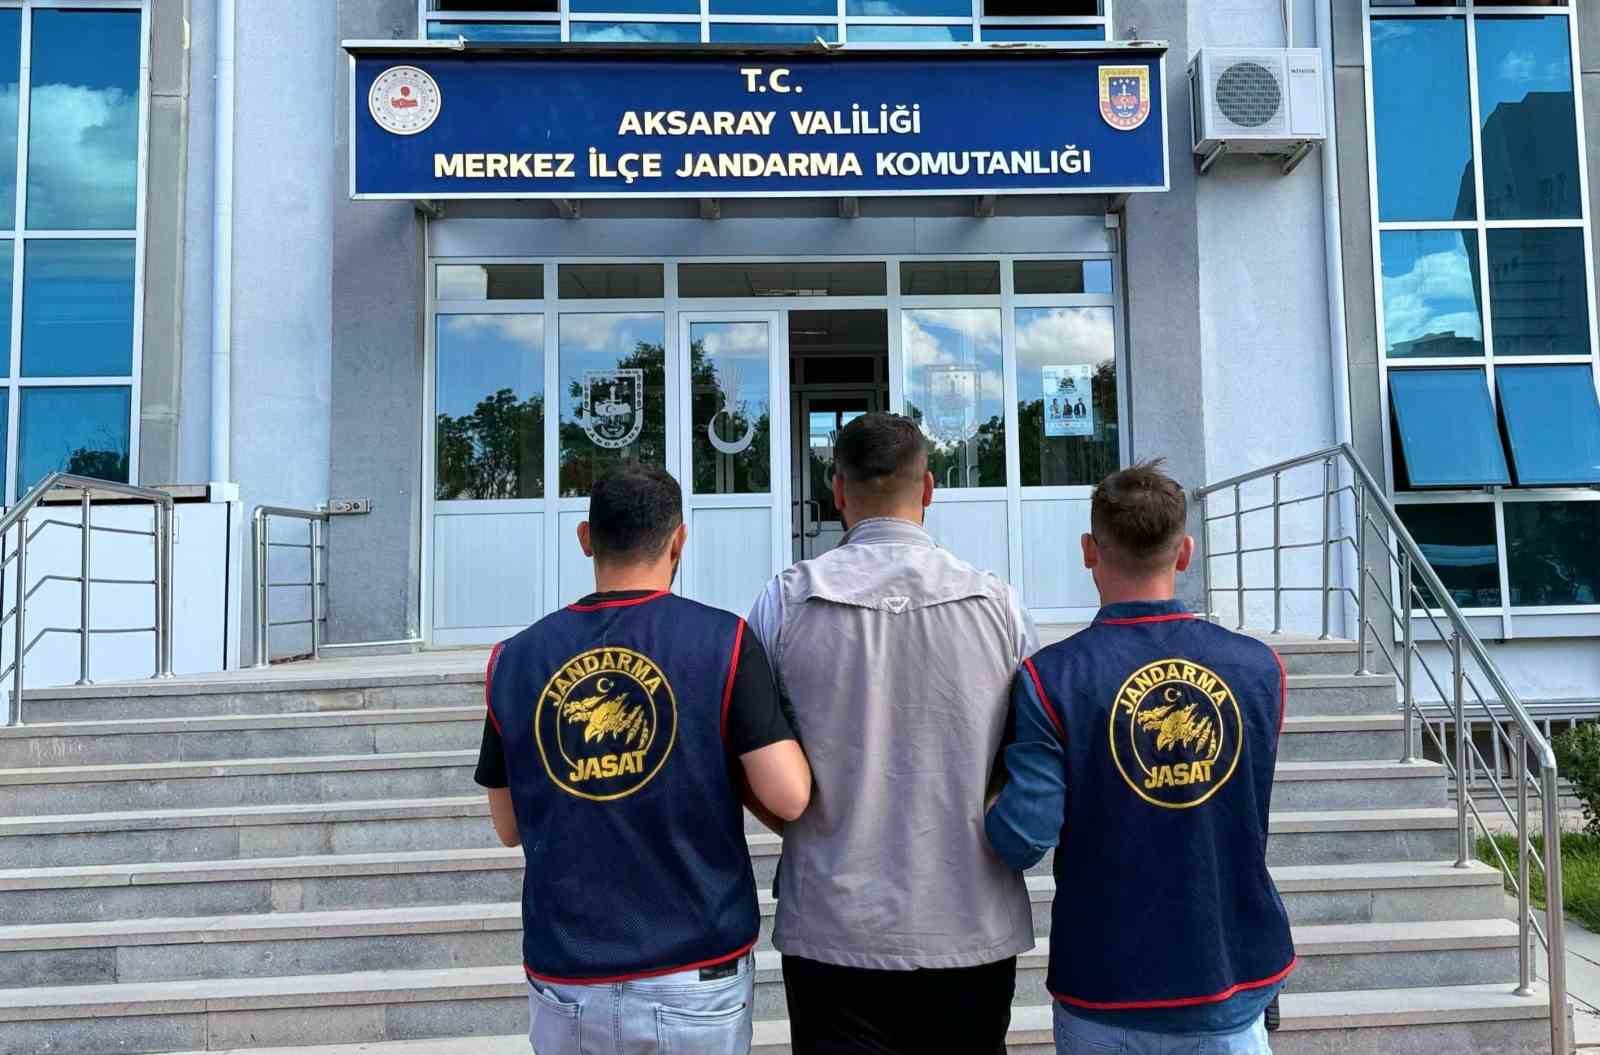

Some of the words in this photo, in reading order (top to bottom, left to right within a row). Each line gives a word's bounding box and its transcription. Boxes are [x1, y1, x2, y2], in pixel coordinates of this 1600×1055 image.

[740, 68, 803, 93] T.C.
[617, 110, 777, 136] AKSARAY
[790, 103, 921, 135] VALİLİĞİ
[434, 153, 576, 178] MERKEZ
[588, 146, 662, 184] İLÇE
[675, 152, 863, 178] JANDARMA
[876, 144, 1091, 176] KOMUTANLIĞI
[547, 652, 661, 707] JANDARMA
[1119, 663, 1228, 715] JANDARMA
[569, 750, 648, 782] JASAT
[1144, 760, 1215, 789] JASAT
